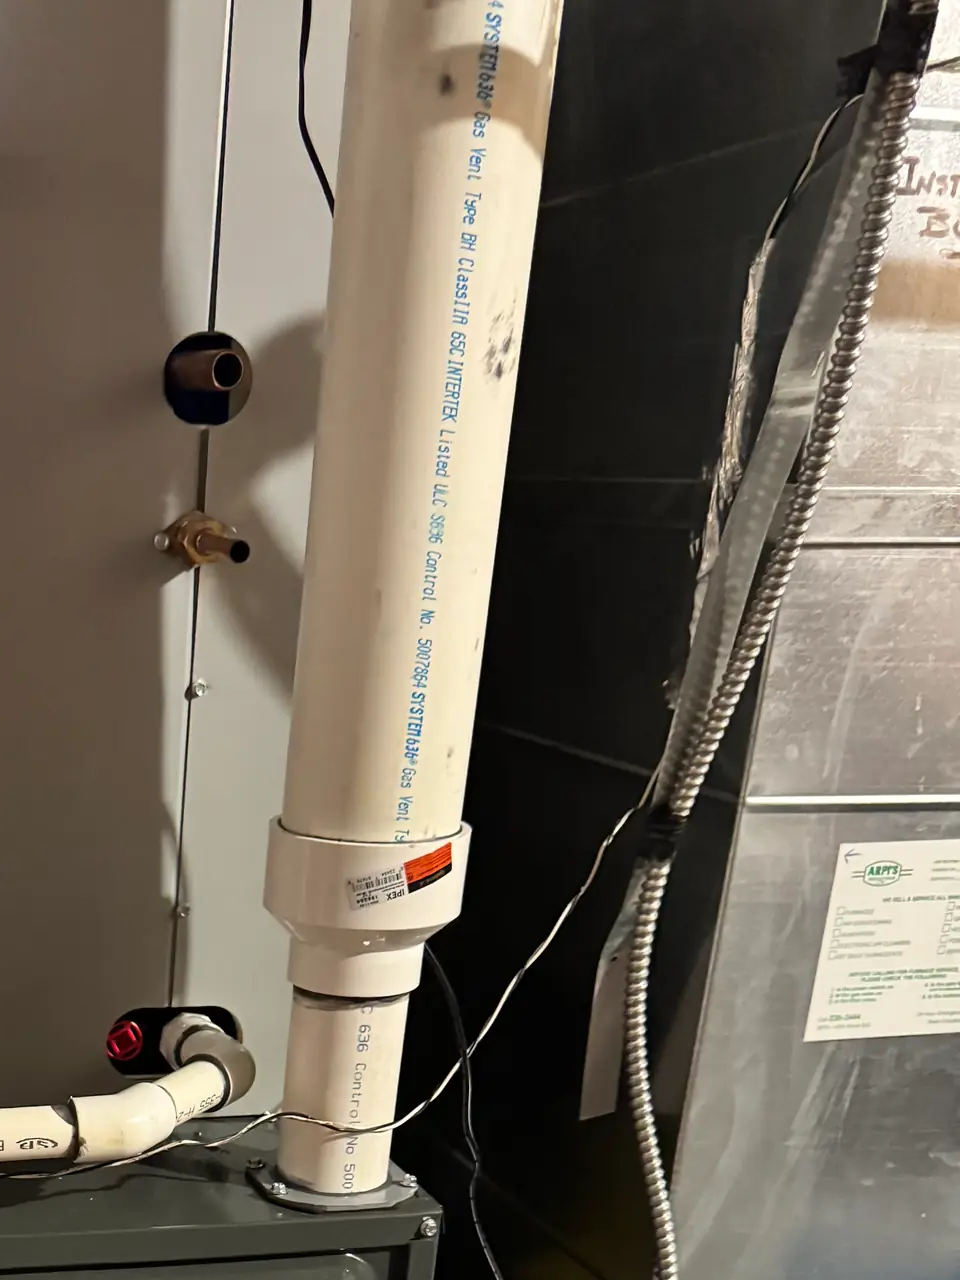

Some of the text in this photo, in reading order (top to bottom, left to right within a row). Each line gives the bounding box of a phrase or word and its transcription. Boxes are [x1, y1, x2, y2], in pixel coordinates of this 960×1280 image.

[472, 110, 490, 139] Gas
[467, 148, 487, 181] Vent
[462, 192, 482, 225] Type
[460, 232, 477, 252] BH
[449, 331, 466, 358] 65C
[441, 359, 464, 424] INTERTEK
[435, 428, 456, 478] Listed
[432, 483, 449, 507] ULC
[422, 551, 442, 601] Control
[419, 608, 435, 630] No.
[411, 638, 433, 689] 5007864
[400, 767, 417, 789] Gas
[395, 795, 414, 822] Vent
[386, 889, 405, 901] IPEX
[356, 1024, 371, 1053] 636
[348, 1062, 367, 1126] Control
[345, 1136, 359, 1155] No
